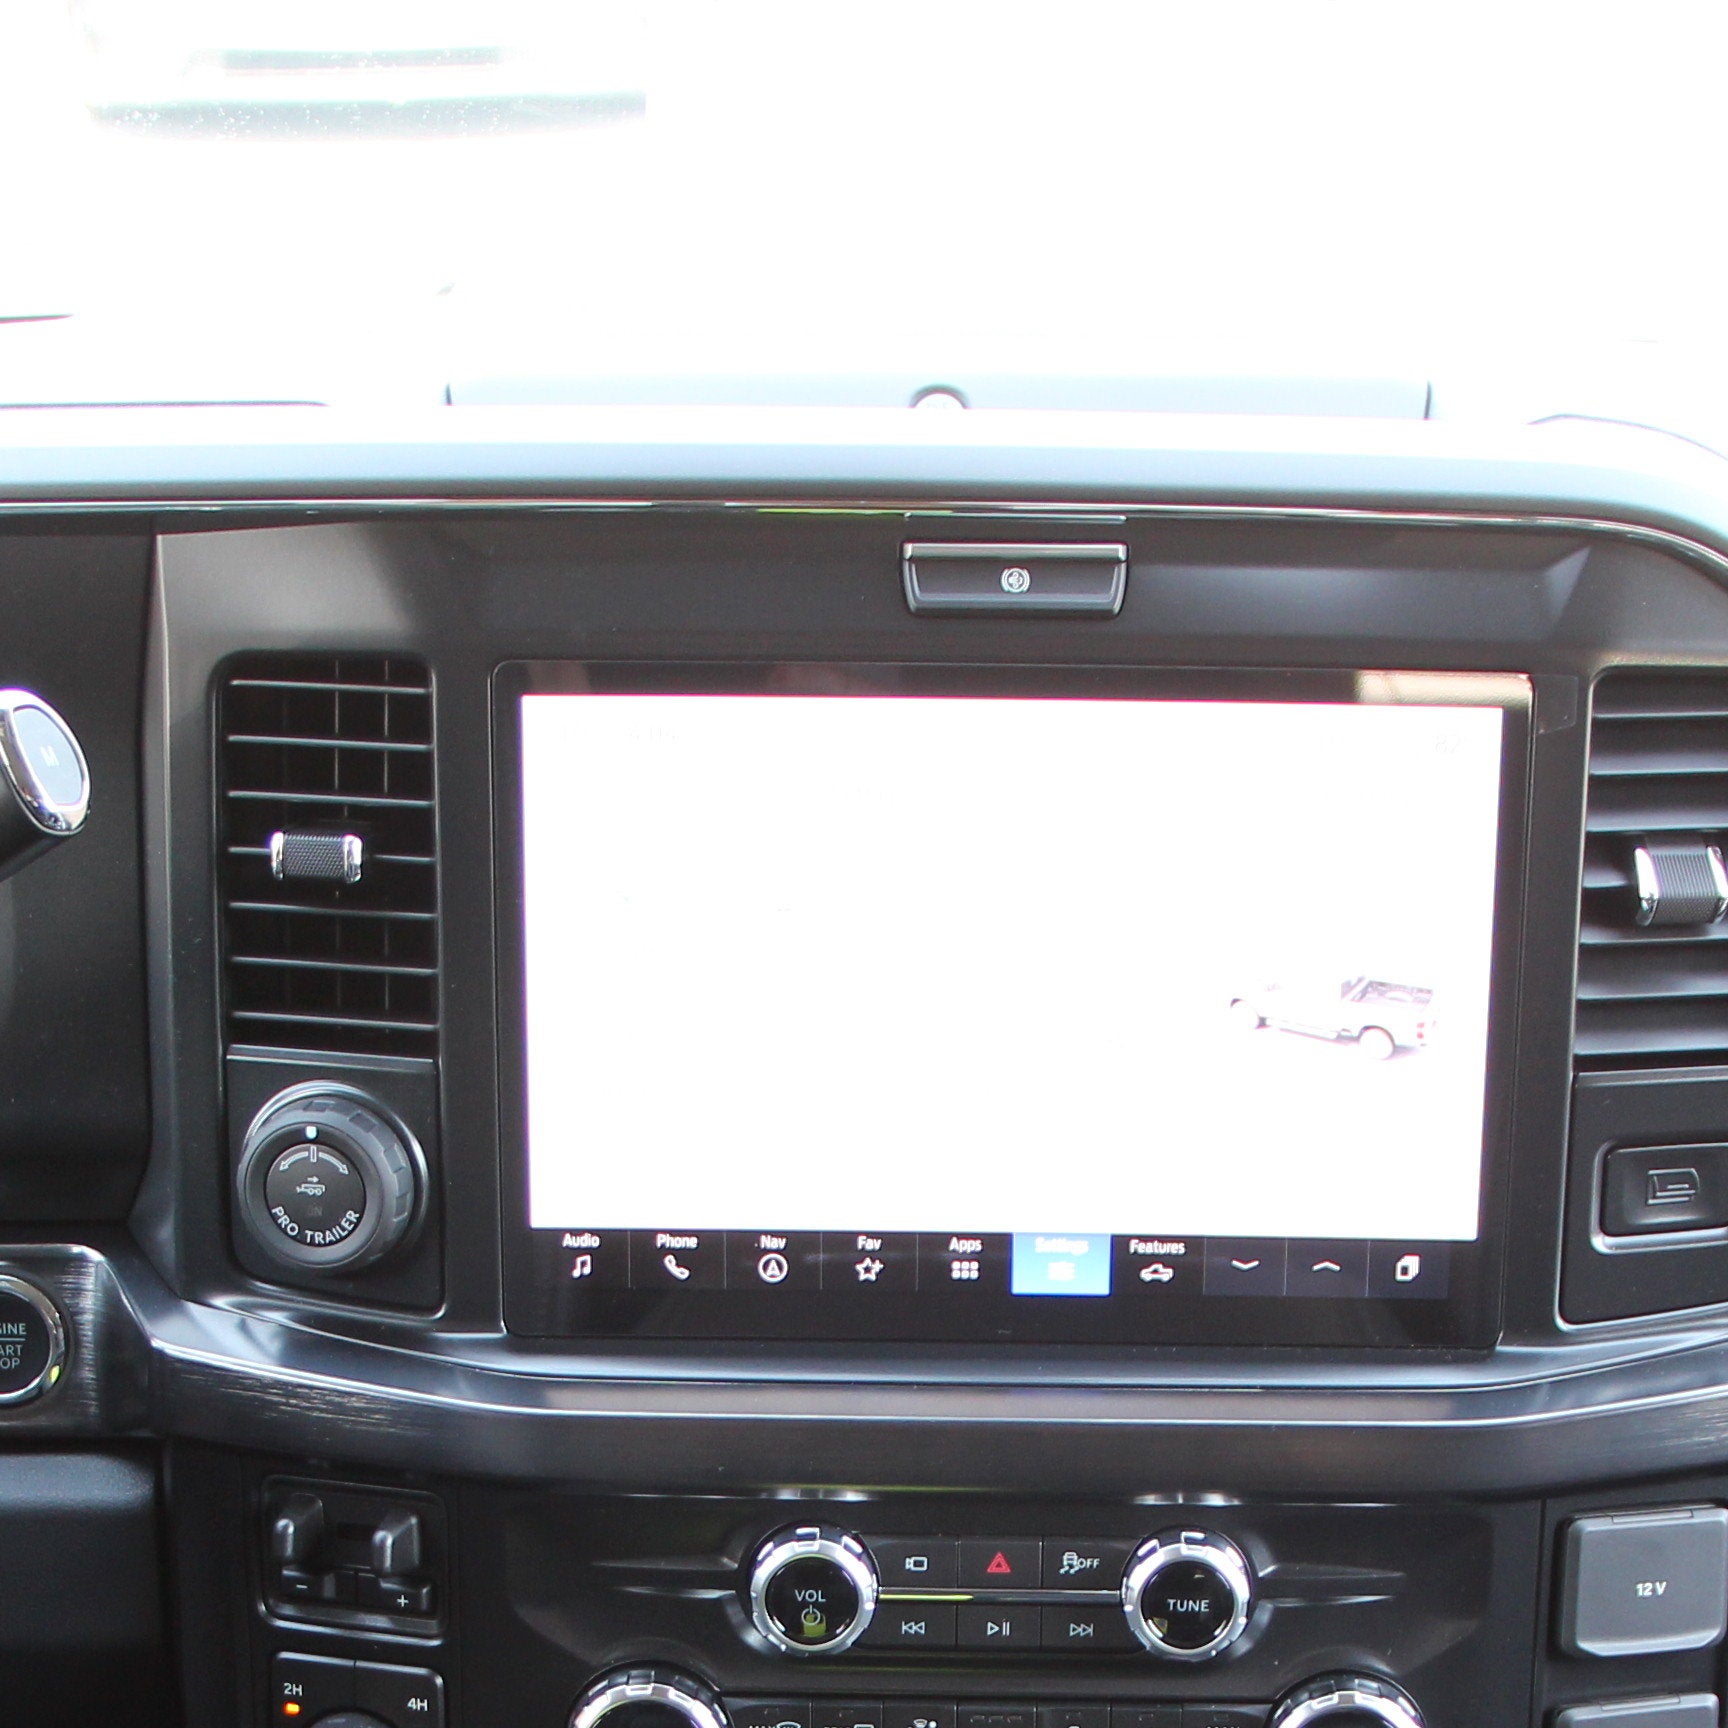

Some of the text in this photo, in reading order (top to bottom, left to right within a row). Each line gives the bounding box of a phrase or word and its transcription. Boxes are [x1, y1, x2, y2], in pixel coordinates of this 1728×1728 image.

[39, 745, 60, 768] M
[272, 1206, 360, 1244] PRO TRAILER
[562, 1233, 601, 1249] Audio
[656, 1234, 699, 1249] Phone
[760, 1235, 787, 1250] Nav
[857, 1235, 883, 1250] Fav
[948, 1236, 983, 1253] Apps
[1129, 1238, 1186, 1256] Features
[1078, 1557, 1100, 1569] OFF
[794, 1589, 827, 1602] VOL
[1167, 1599, 1210, 1612] TUNE
[284, 1682, 303, 1697] 2H
[407, 1697, 428, 1712] 4H
